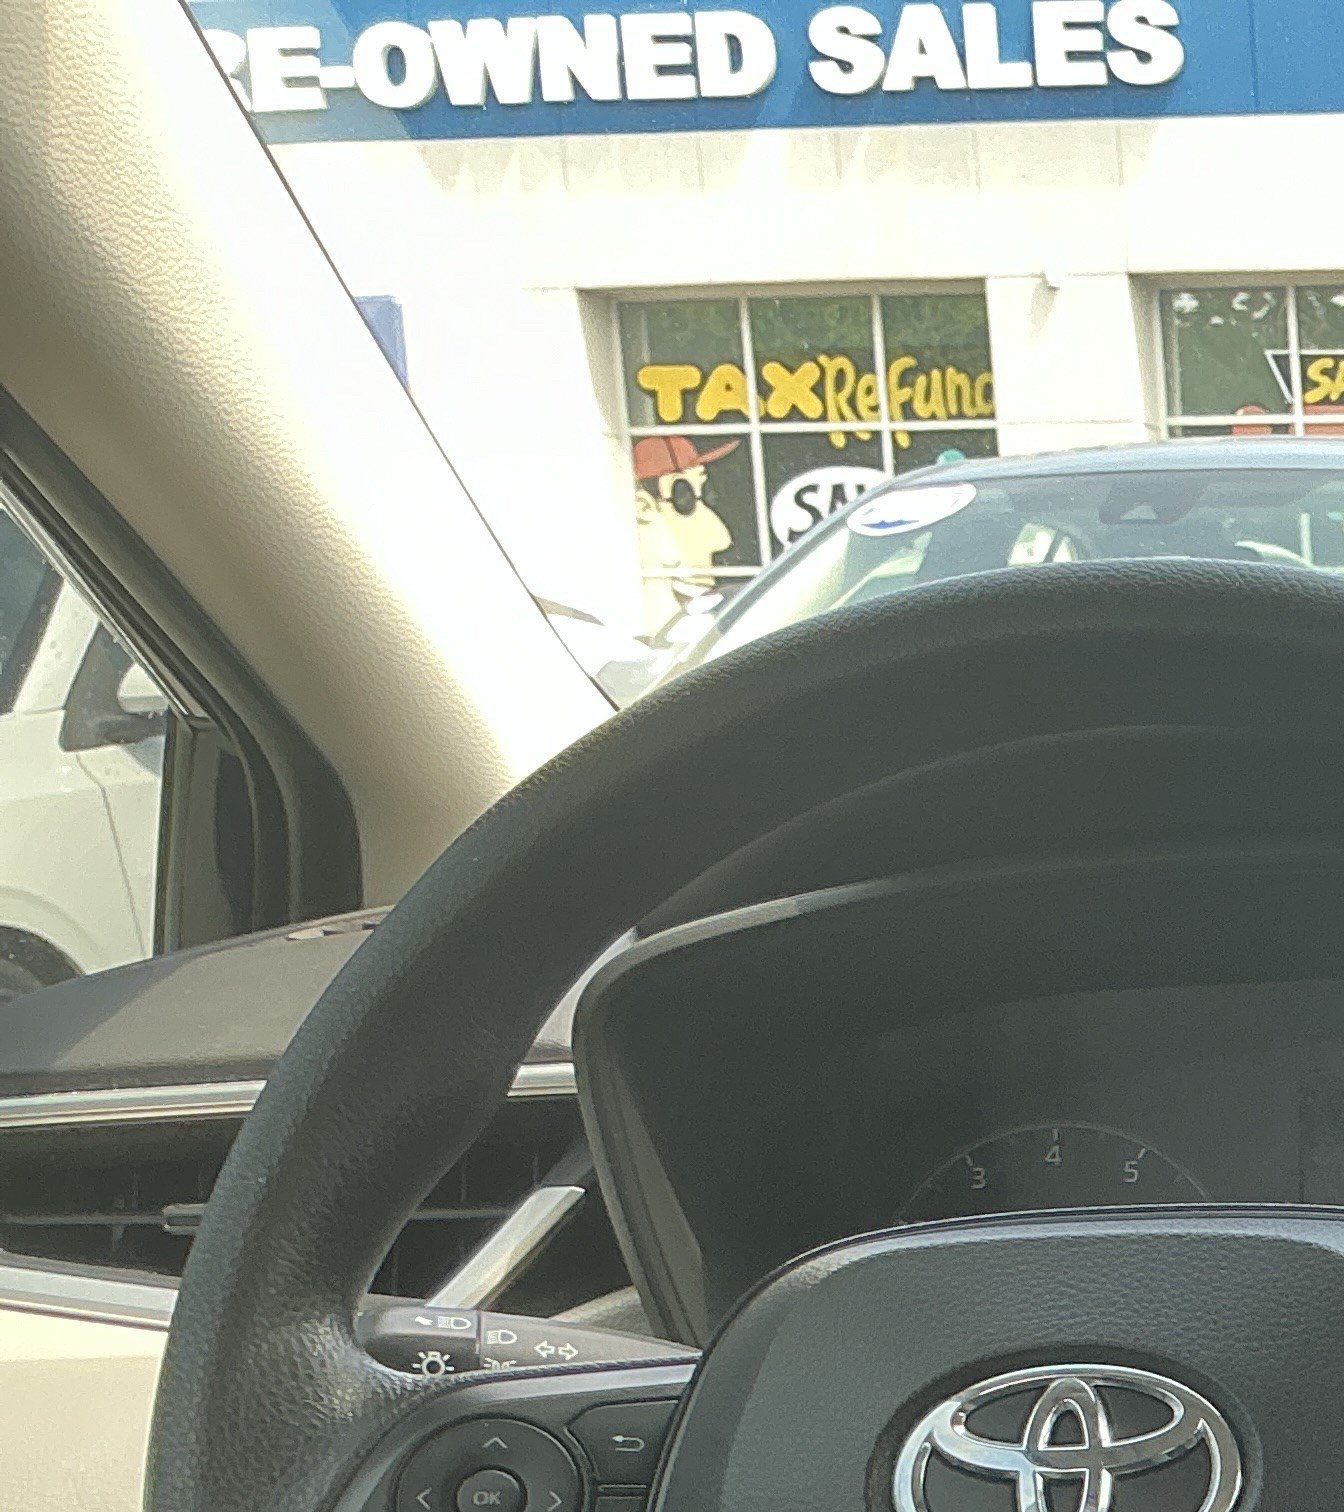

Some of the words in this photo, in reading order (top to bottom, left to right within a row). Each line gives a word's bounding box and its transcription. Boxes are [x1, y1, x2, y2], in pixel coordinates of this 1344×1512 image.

[807, 0, 1185, 96] SALES
[637, 361, 826, 422] TAX
[1045, 1145, 1063, 1166] 4
[970, 1167, 987, 1190] 3
[1124, 1160, 1139, 1182] 5
[472, 1490, 502, 1506] OK
